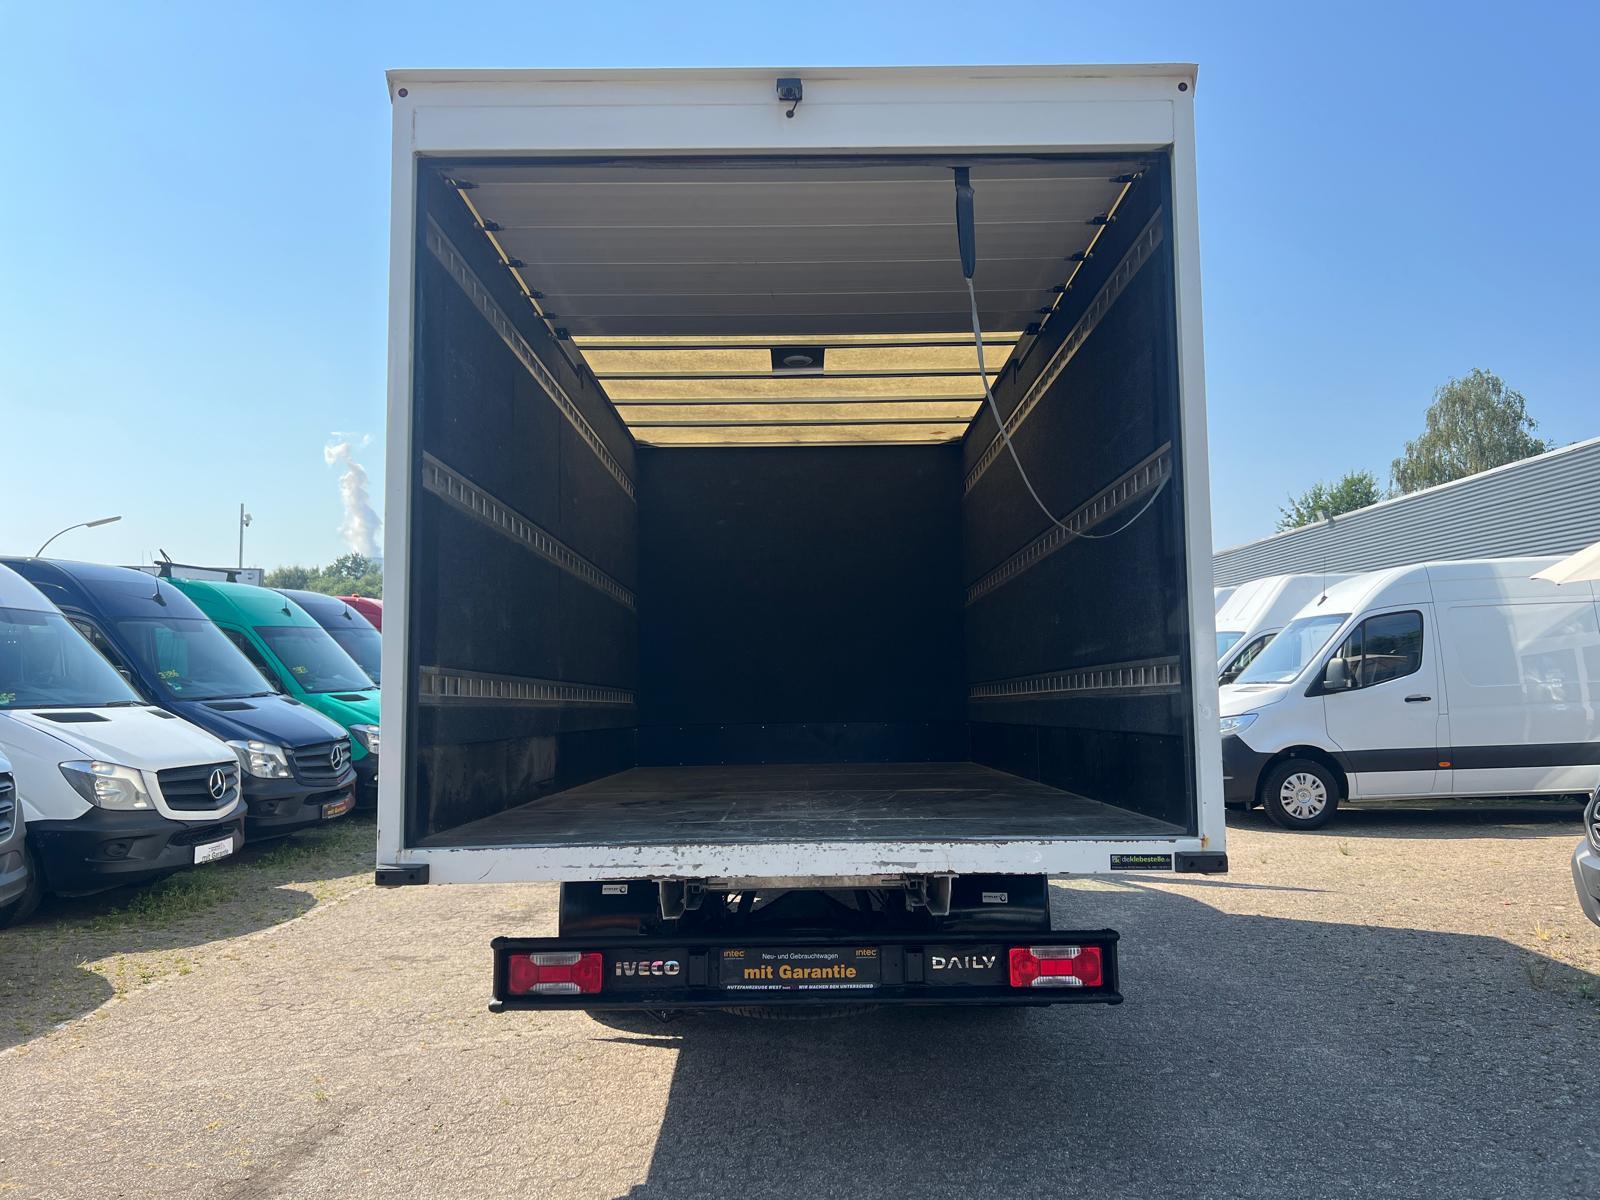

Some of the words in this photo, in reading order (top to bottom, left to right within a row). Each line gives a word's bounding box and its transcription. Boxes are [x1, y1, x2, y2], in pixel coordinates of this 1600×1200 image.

[790, 952, 839, 960] Gebrauchtwagen
[932, 956, 996, 969] DAILY
[615, 960, 680, 976] IVECO
[744, 965, 773, 979] mit
[779, 964, 857, 979] Garantie
